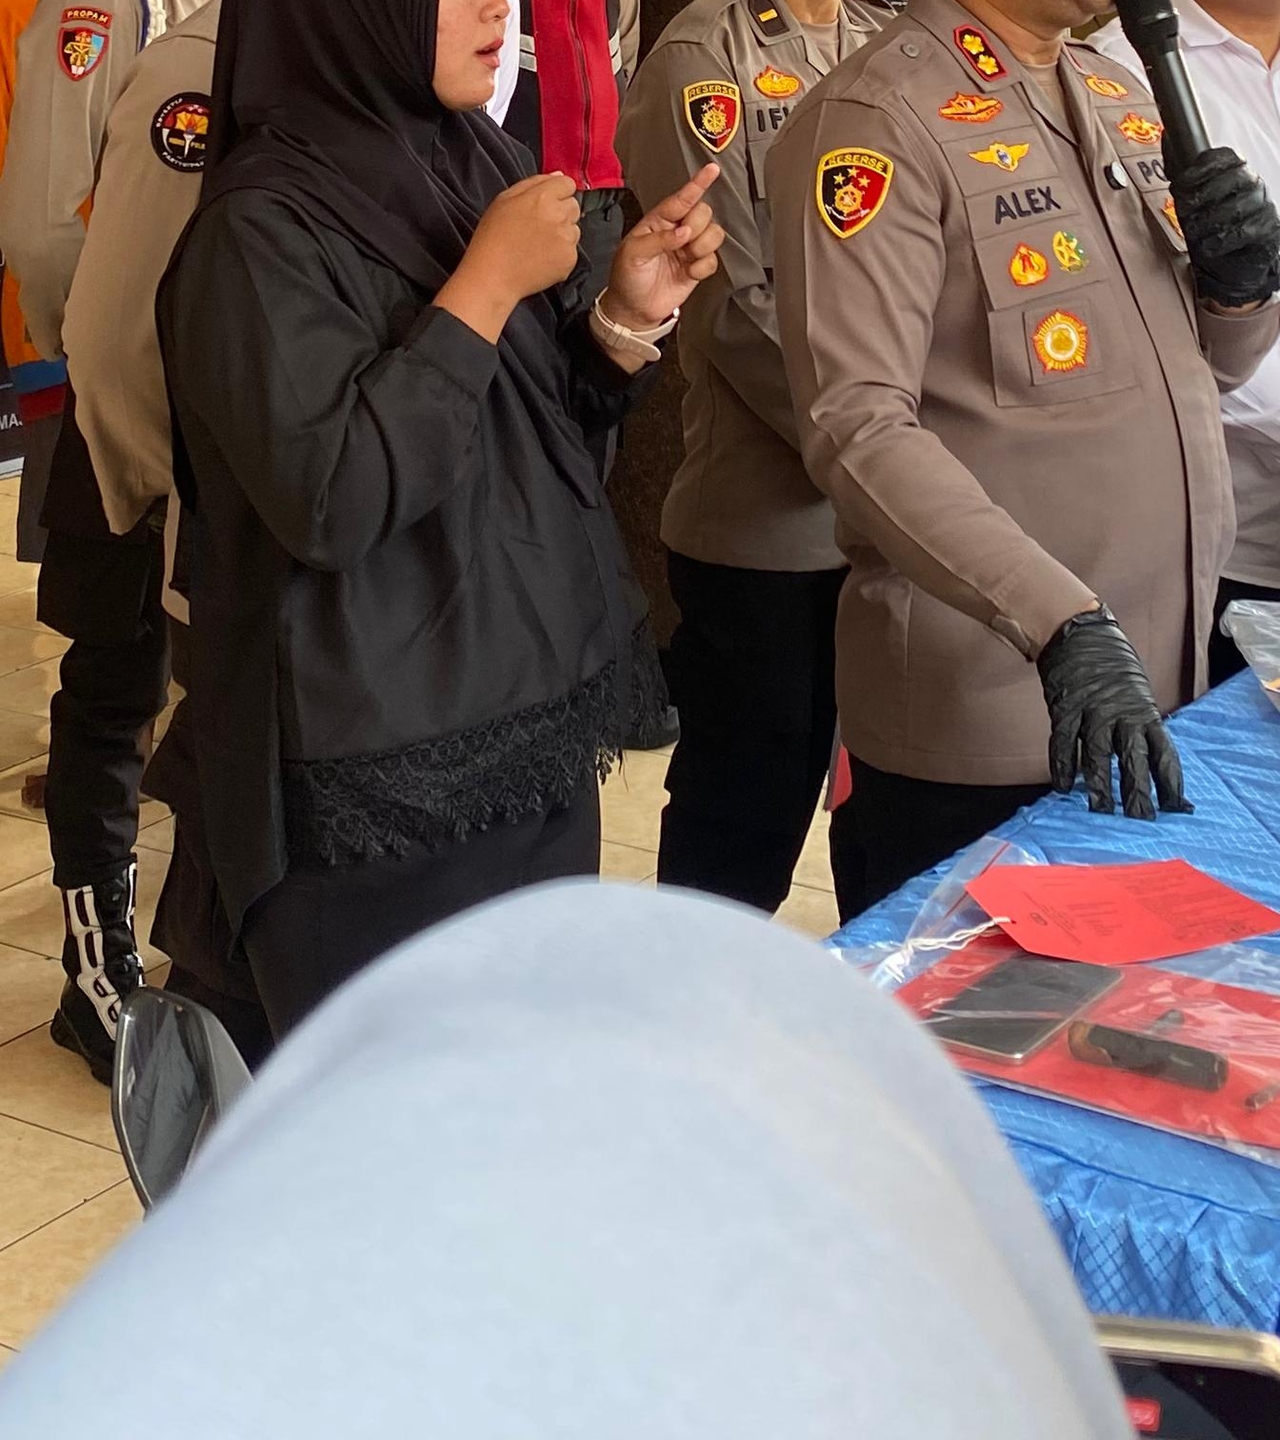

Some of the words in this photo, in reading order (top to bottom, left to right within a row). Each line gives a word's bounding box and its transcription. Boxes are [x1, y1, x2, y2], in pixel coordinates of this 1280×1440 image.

[67, 10, 108, 23] PROPAM
[689, 85, 736, 97] RESERSE
[828, 153, 885, 171] RESERSE
[995, 186, 1061, 225] ALEX
